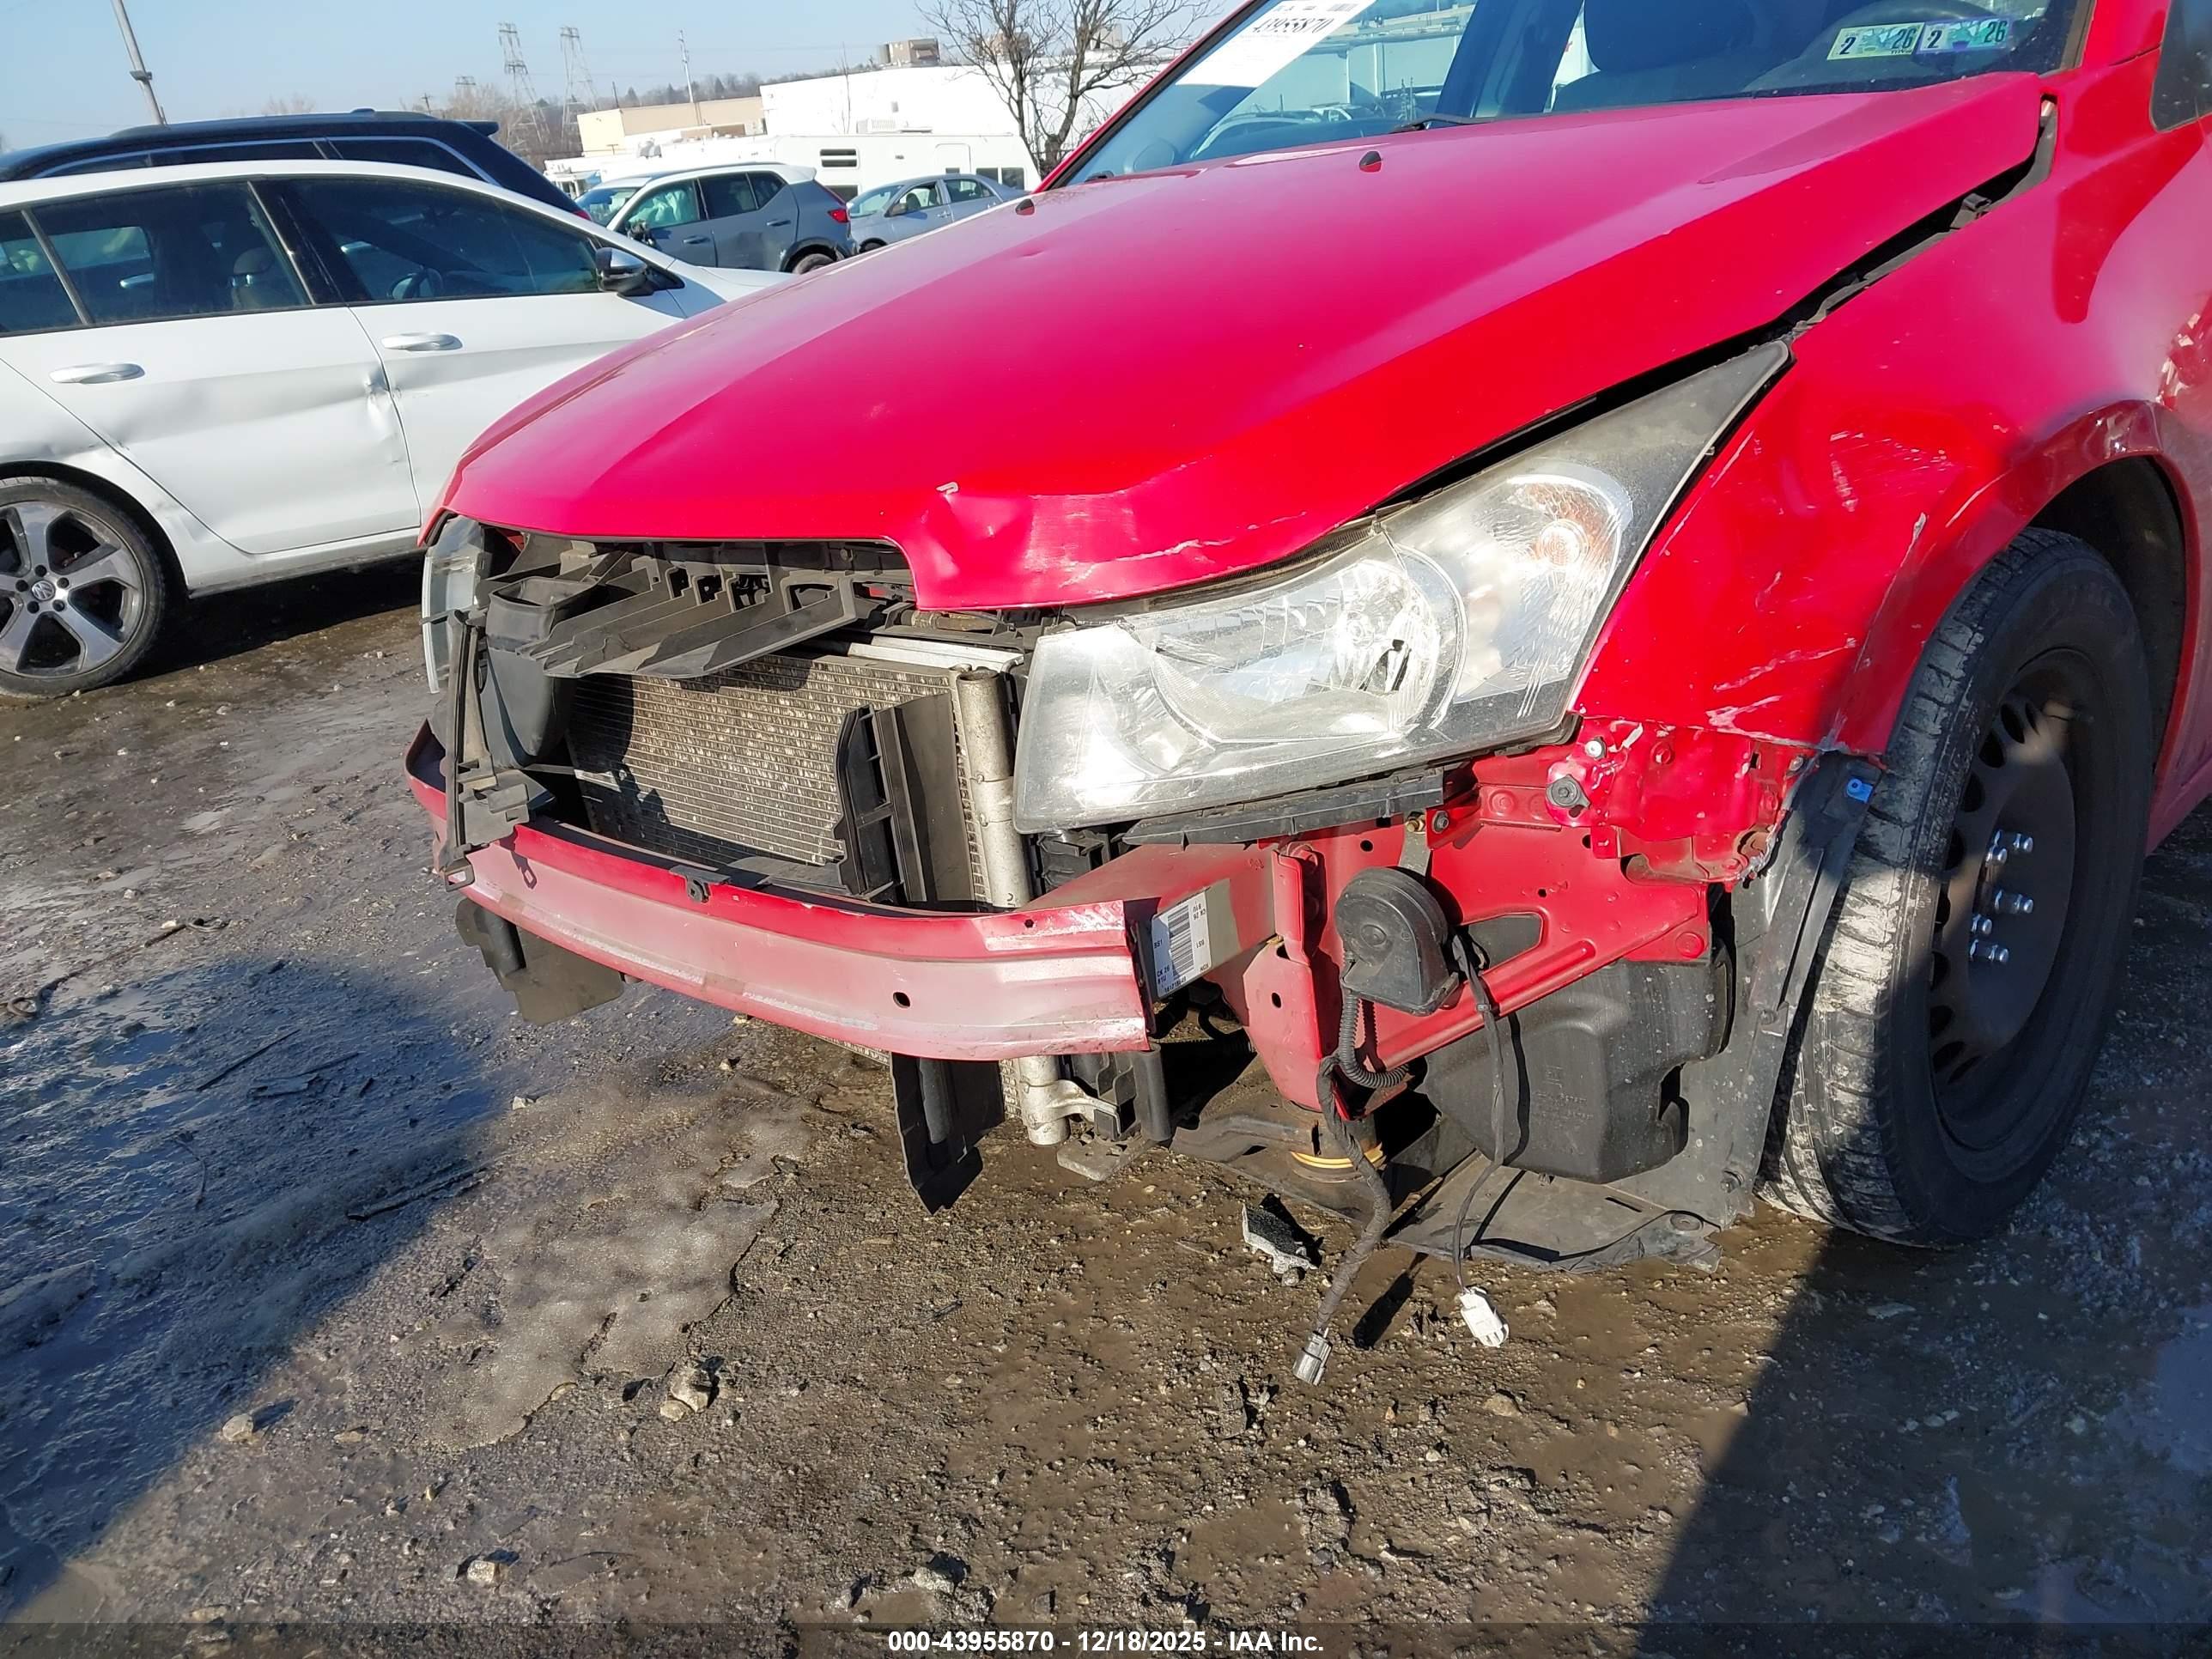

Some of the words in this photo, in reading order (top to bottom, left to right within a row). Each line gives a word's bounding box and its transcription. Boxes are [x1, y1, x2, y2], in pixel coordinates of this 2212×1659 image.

[1839, 36, 1856, 55] 2
[1892, 27, 1917, 50] 26
[1928, 29, 1942, 49] 2
[1984, 21, 2008, 44] 26
